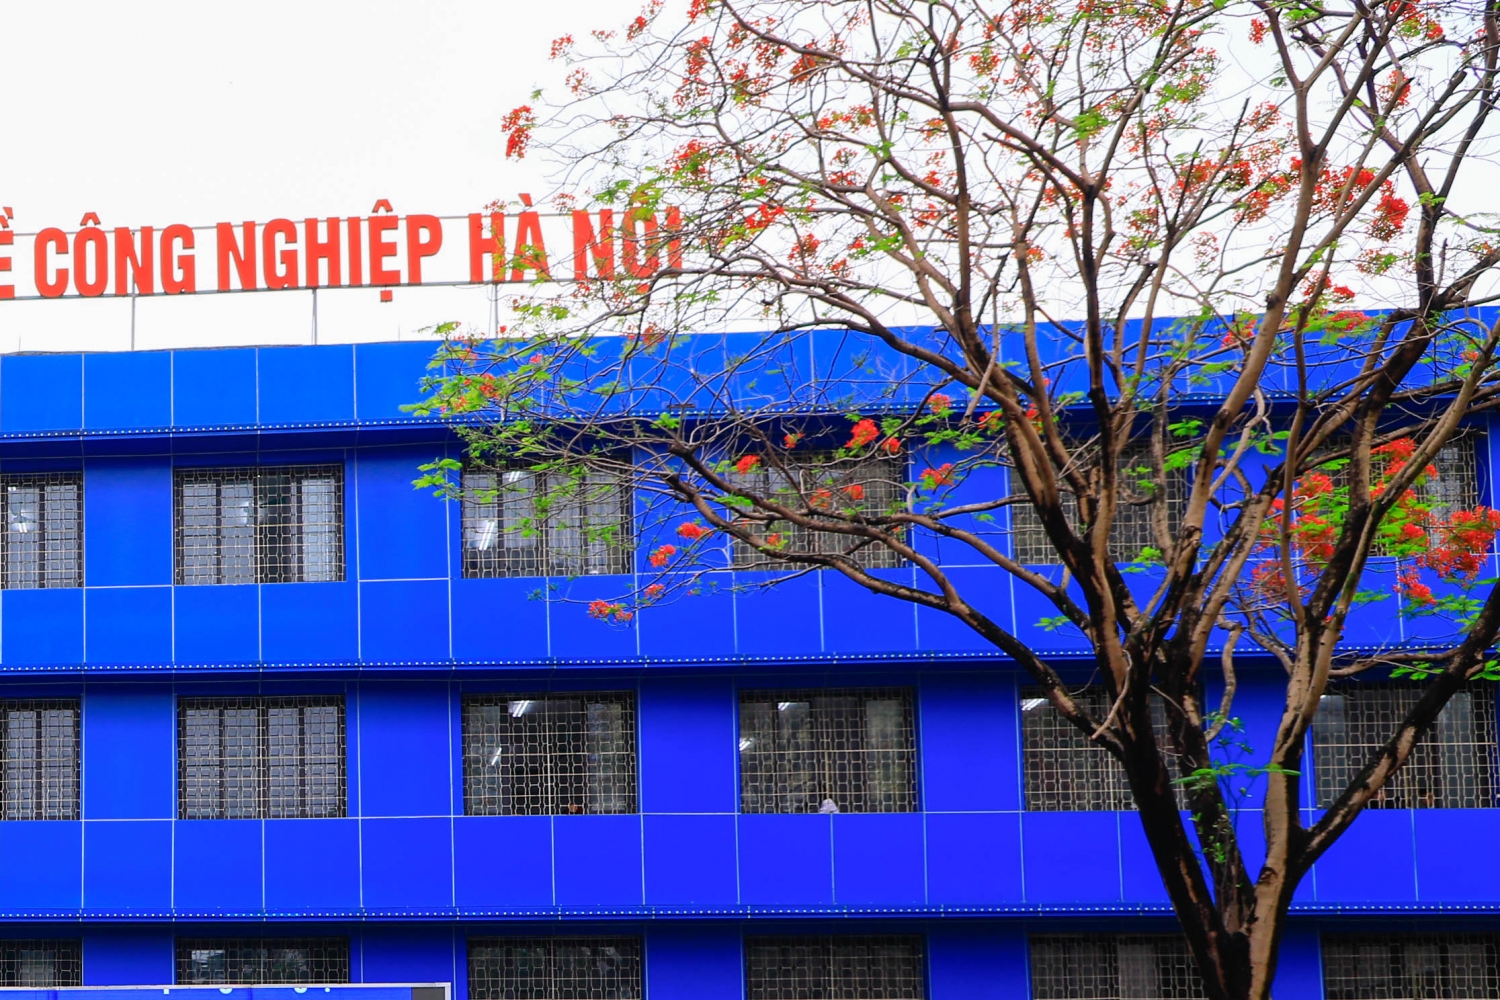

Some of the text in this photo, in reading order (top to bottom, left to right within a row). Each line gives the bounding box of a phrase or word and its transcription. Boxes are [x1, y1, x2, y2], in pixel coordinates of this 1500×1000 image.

[33, 211, 196, 298] CÔNG
[216, 199, 444, 302] NGHIỆP
[468, 193, 551, 283] HÀ
